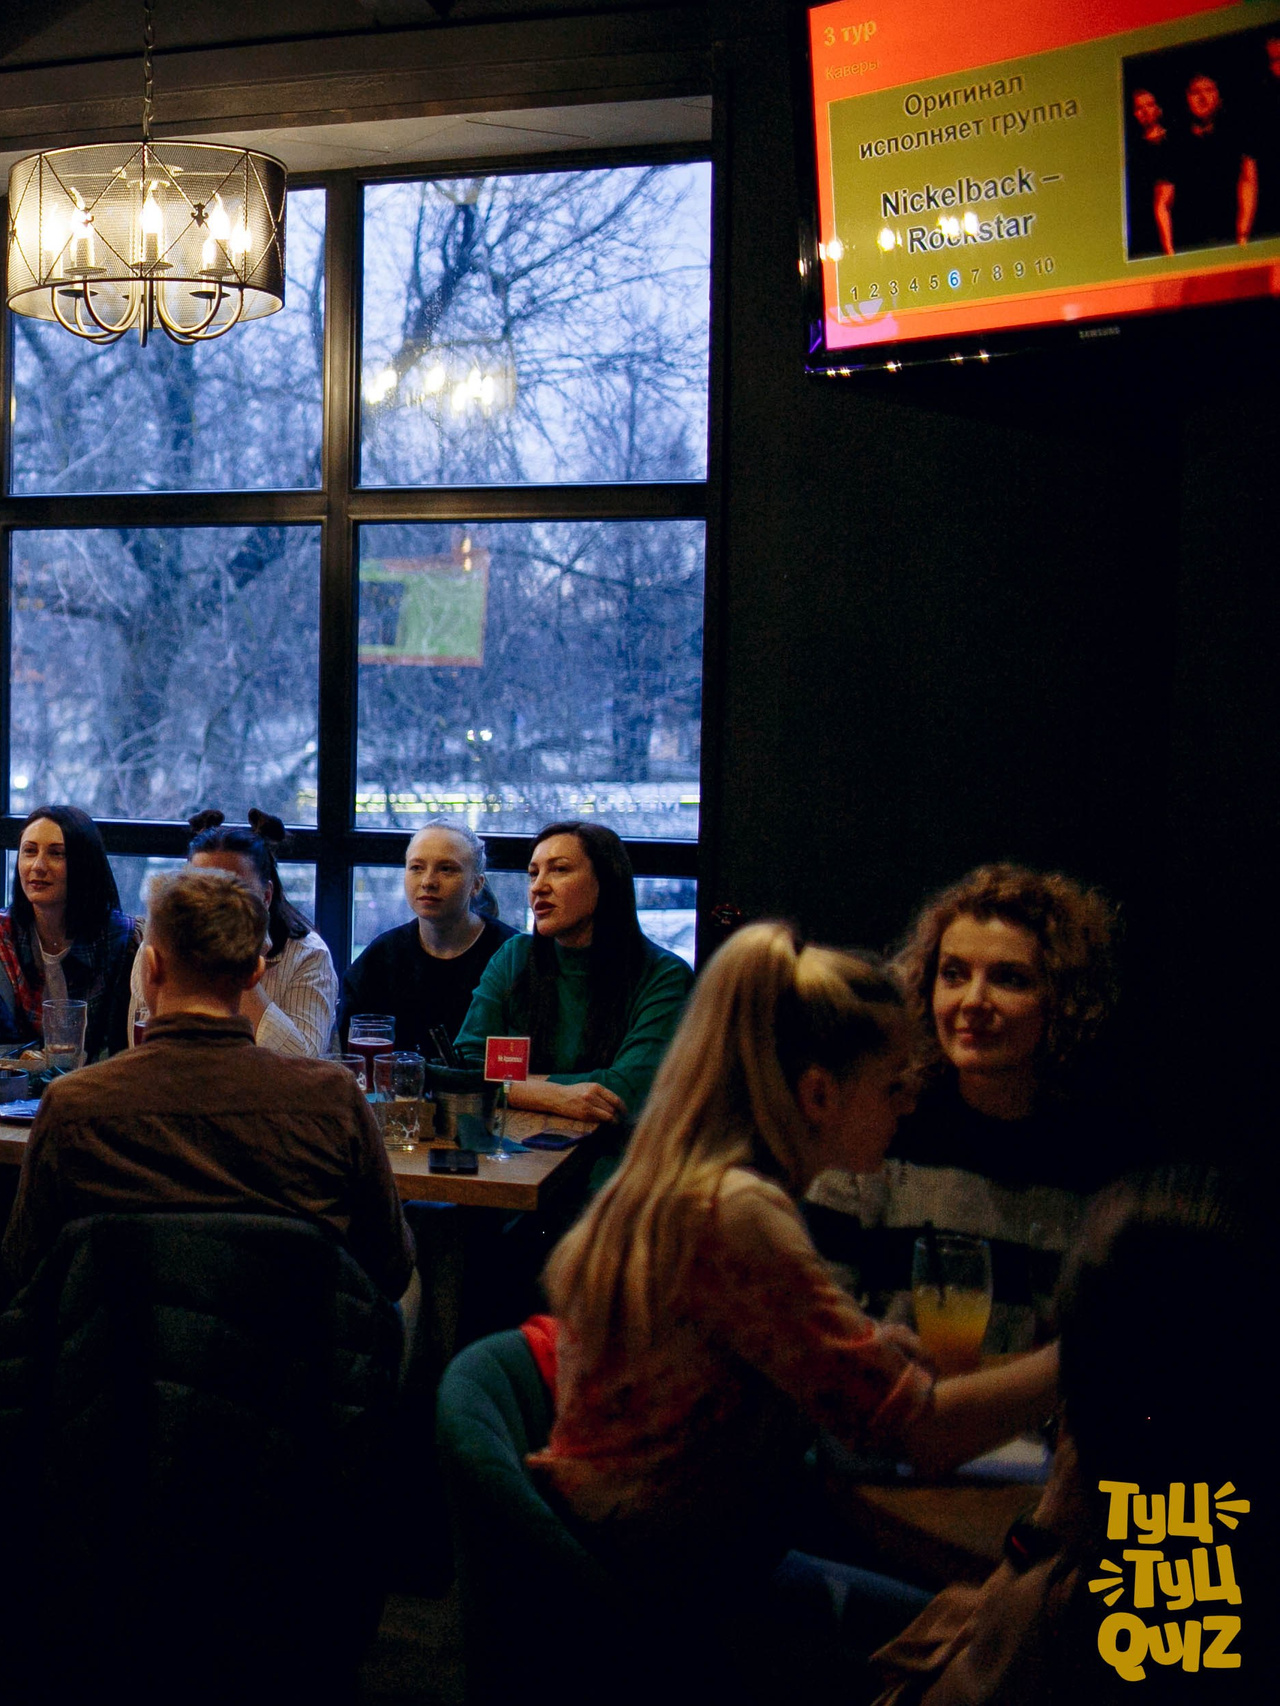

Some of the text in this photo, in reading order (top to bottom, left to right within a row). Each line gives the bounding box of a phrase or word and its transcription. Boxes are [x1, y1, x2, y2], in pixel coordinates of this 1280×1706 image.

[823, 20, 877, 47] 3 тур
[825, 60, 880, 80] Каверы
[904, 74, 1024, 118] Оригинал
[859, 98, 1079, 160] исполняет группа
[881, 167, 1035, 218] Nickelback
[851, 256, 1055, 300] 1 2 3 4 5 6 7 8 9 10
